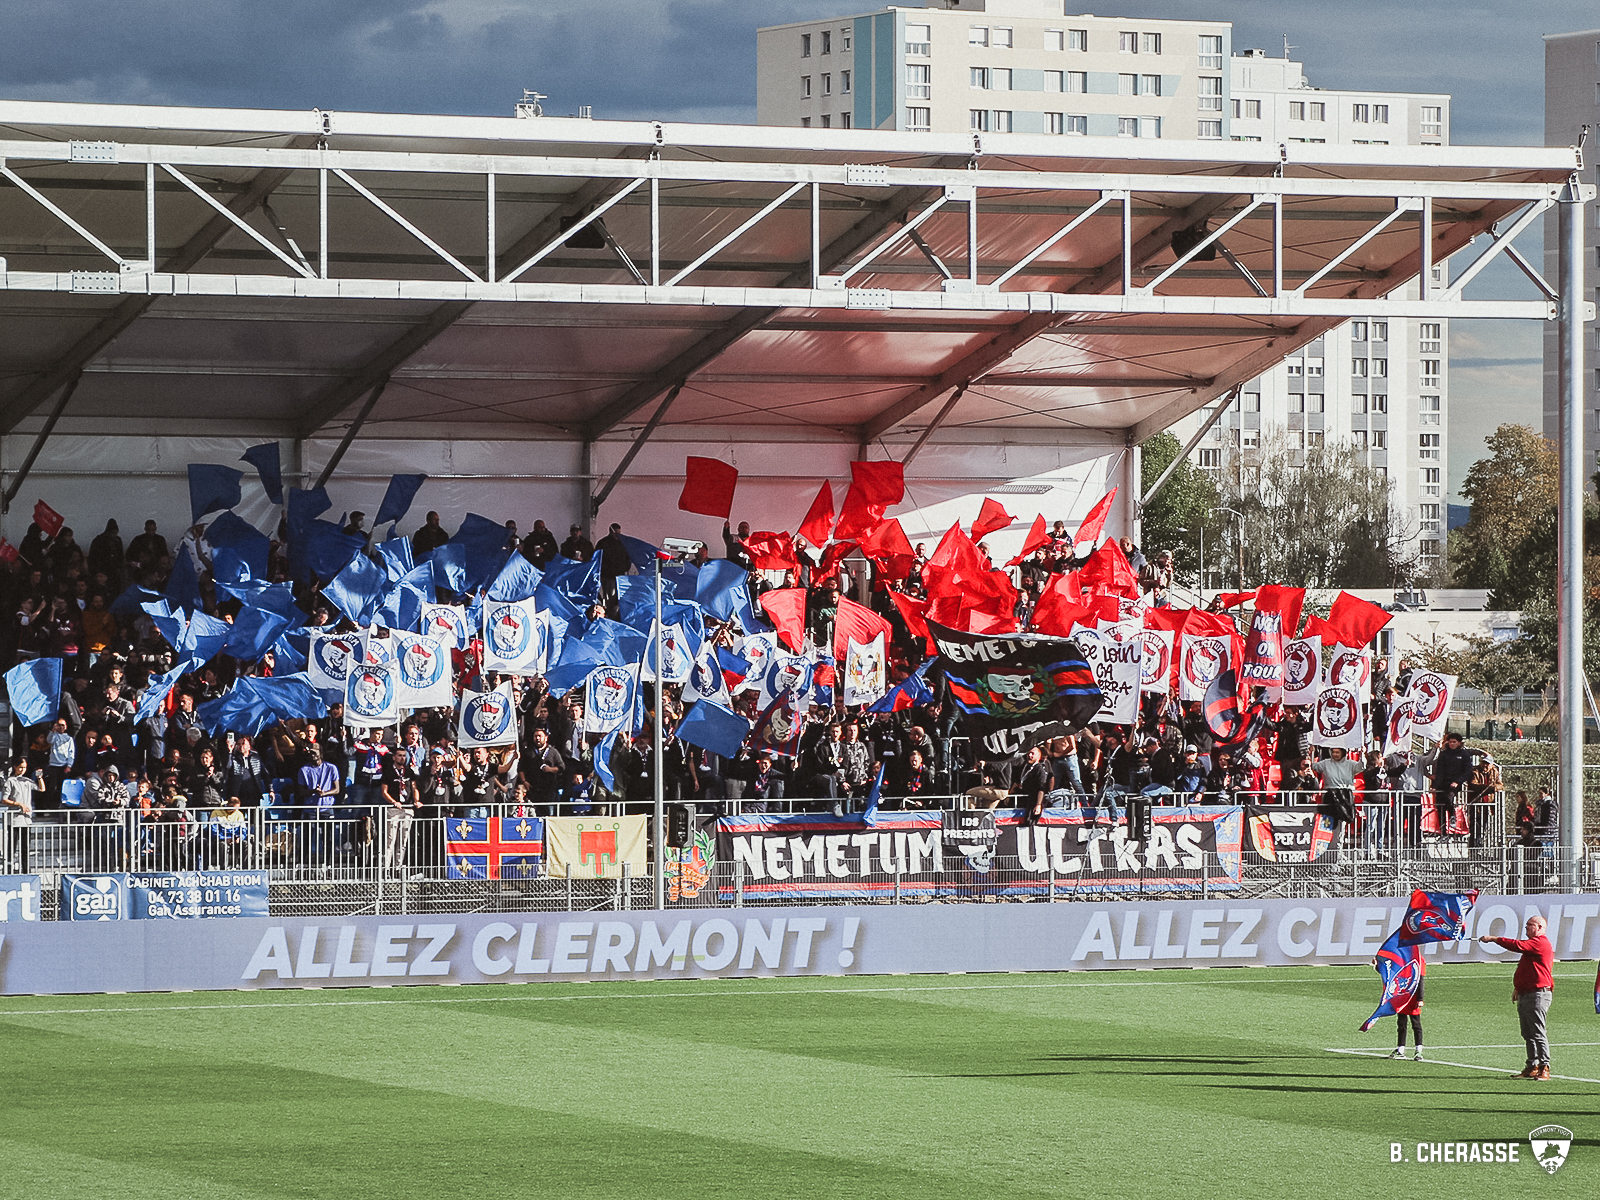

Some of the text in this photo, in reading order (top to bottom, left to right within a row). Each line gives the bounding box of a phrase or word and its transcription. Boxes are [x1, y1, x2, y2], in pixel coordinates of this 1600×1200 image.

[732, 830, 945, 882] NEMETUM
[126, 877, 177, 889] CABINET
[233, 874, 261, 887] RIOM
[76, 893, 117, 915] gan
[148, 891, 165, 904] 04
[168, 891, 185, 904] 73
[205, 889, 221, 903] 01
[225, 889, 241, 903] 16
[173, 904, 241, 916] Assurances
[1071, 908, 1264, 961] ALLEZ
[241, 922, 457, 979] ALLEZ
[471, 917, 826, 976] CLERMONT
